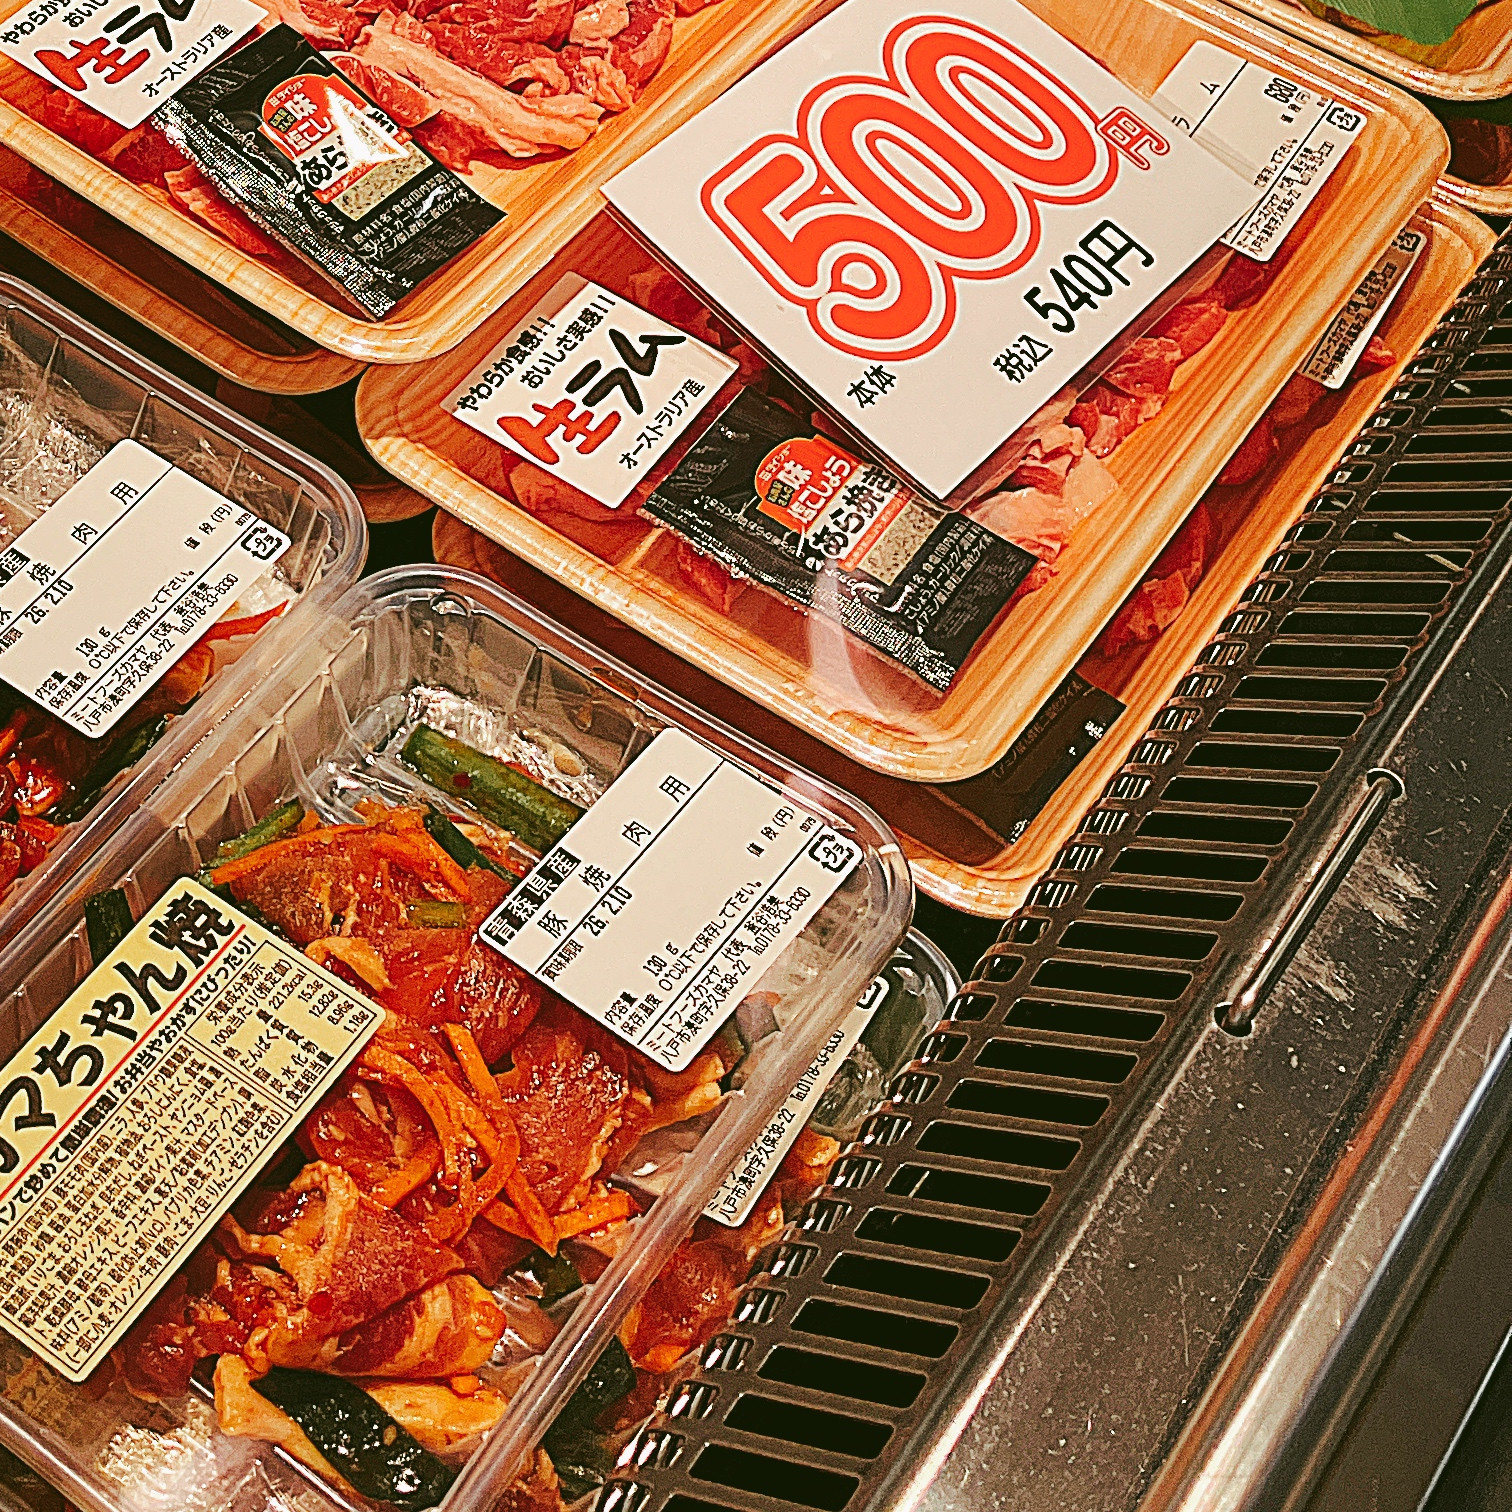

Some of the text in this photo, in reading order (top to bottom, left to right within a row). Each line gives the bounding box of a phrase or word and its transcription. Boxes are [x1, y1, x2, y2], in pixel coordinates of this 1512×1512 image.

[143, 25, 234, 98] オーストラリア産
[1262, 76, 1300, 103] 680
[993, 219, 1155, 381] 税込 540円
[459, 316, 552, 411] やわらか食感!!
[498, 329, 687, 464] 生ラム
[847, 364, 897, 408] 本体
[619, 379, 706, 469] オーストラリア産
[777, 460, 812, 490] 味
[788, 455, 851, 523] 塩こしょう
[811, 466, 897, 557] あら挽き
[23, 602, 50, 624] 26.
[42, 578, 76, 605] 2.10
[149, 619, 175, 642] 代表
[32, 668, 68, 700] 内容量
[74, 637, 99, 657] 130
[46, 670, 92, 710] 保存温度
[484, 850, 578, 944] 青森県産
[539, 884, 634, 982] 賞味期限 26. 2.10
[720, 936, 748, 962] 代表
[203, 960, 267, 1026] 栄養成分表示
[265, 967, 309, 1011] 221.2kcal
[307, 987, 340, 1020] 12.82g
[602, 990, 638, 1026] 内容量
[642, 954, 668, 977] 130
[618, 992, 663, 1037] 保存温度
[237, 977, 325, 1073] たんぱく質 15.3g
[267, 997, 356, 1095] 炭水化物 8.96g
[282, 1008, 371, 1105] 食塩相当量 1.18g
